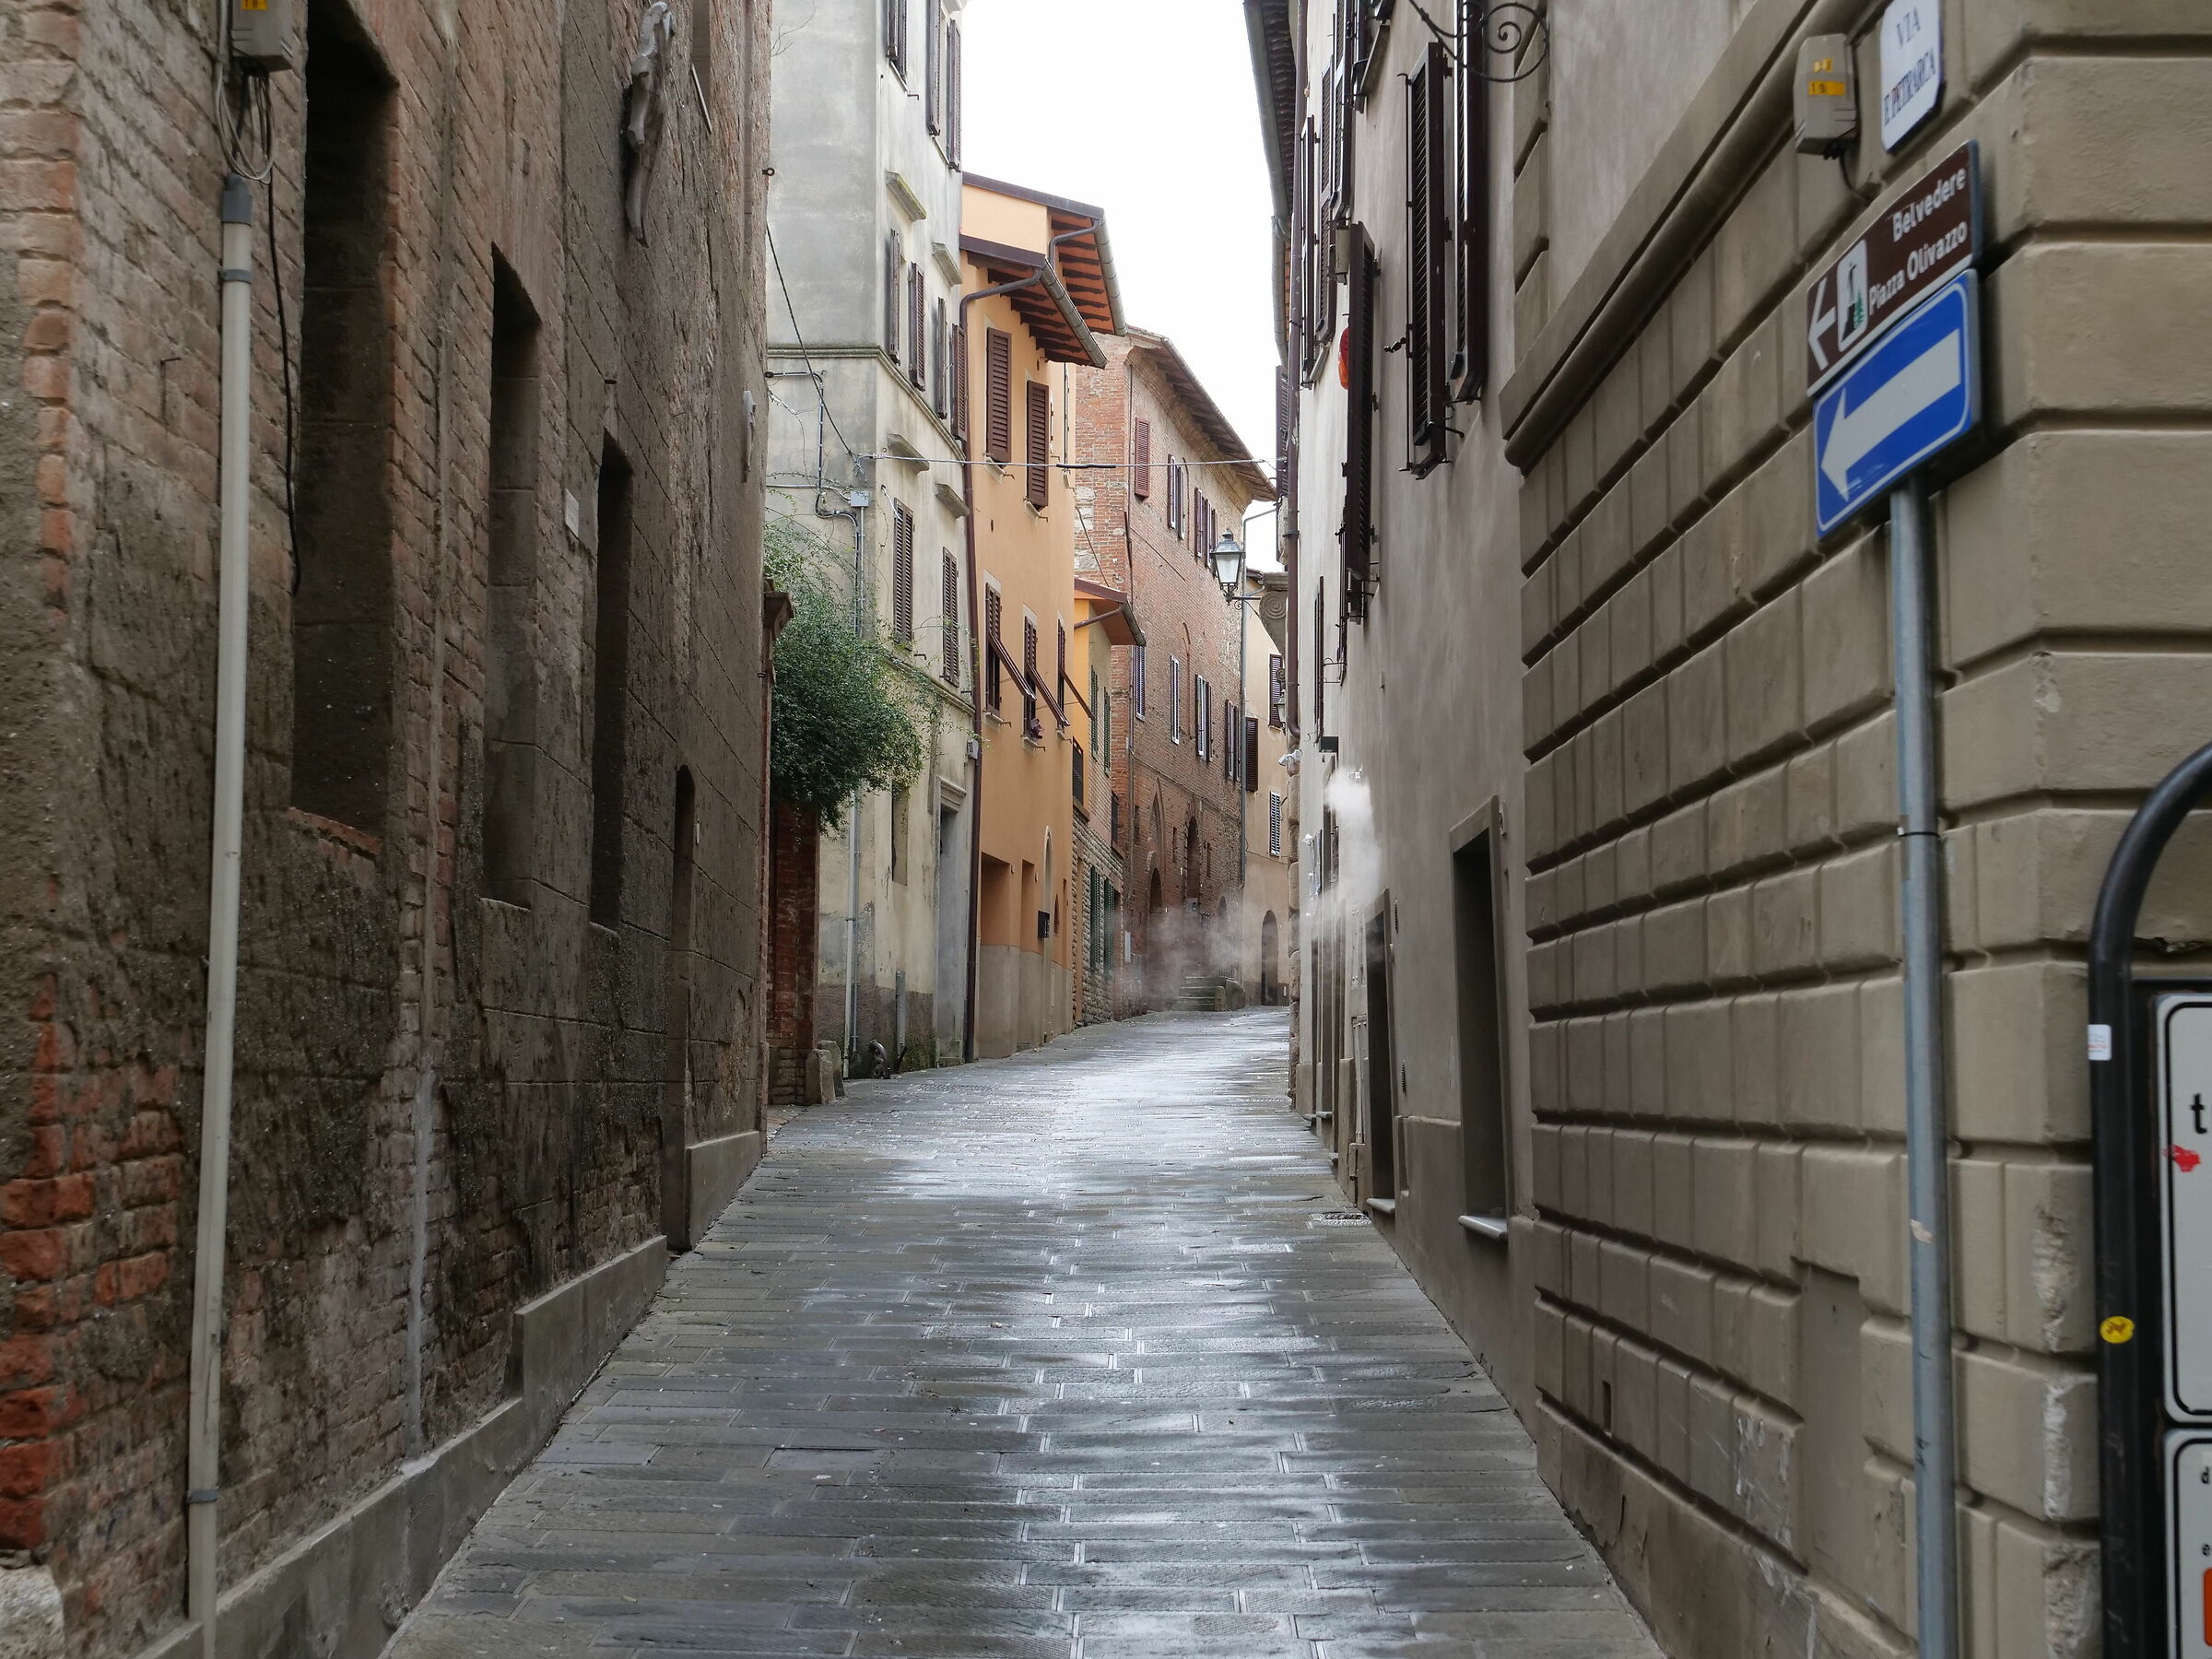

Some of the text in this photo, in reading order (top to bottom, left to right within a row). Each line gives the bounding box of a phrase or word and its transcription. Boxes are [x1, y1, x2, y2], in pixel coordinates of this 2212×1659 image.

[1896, 6, 1922, 48] VIA
[1892, 167, 1967, 242] Belvedere
[1868, 220, 1968, 316] Piazza Olivazzo
